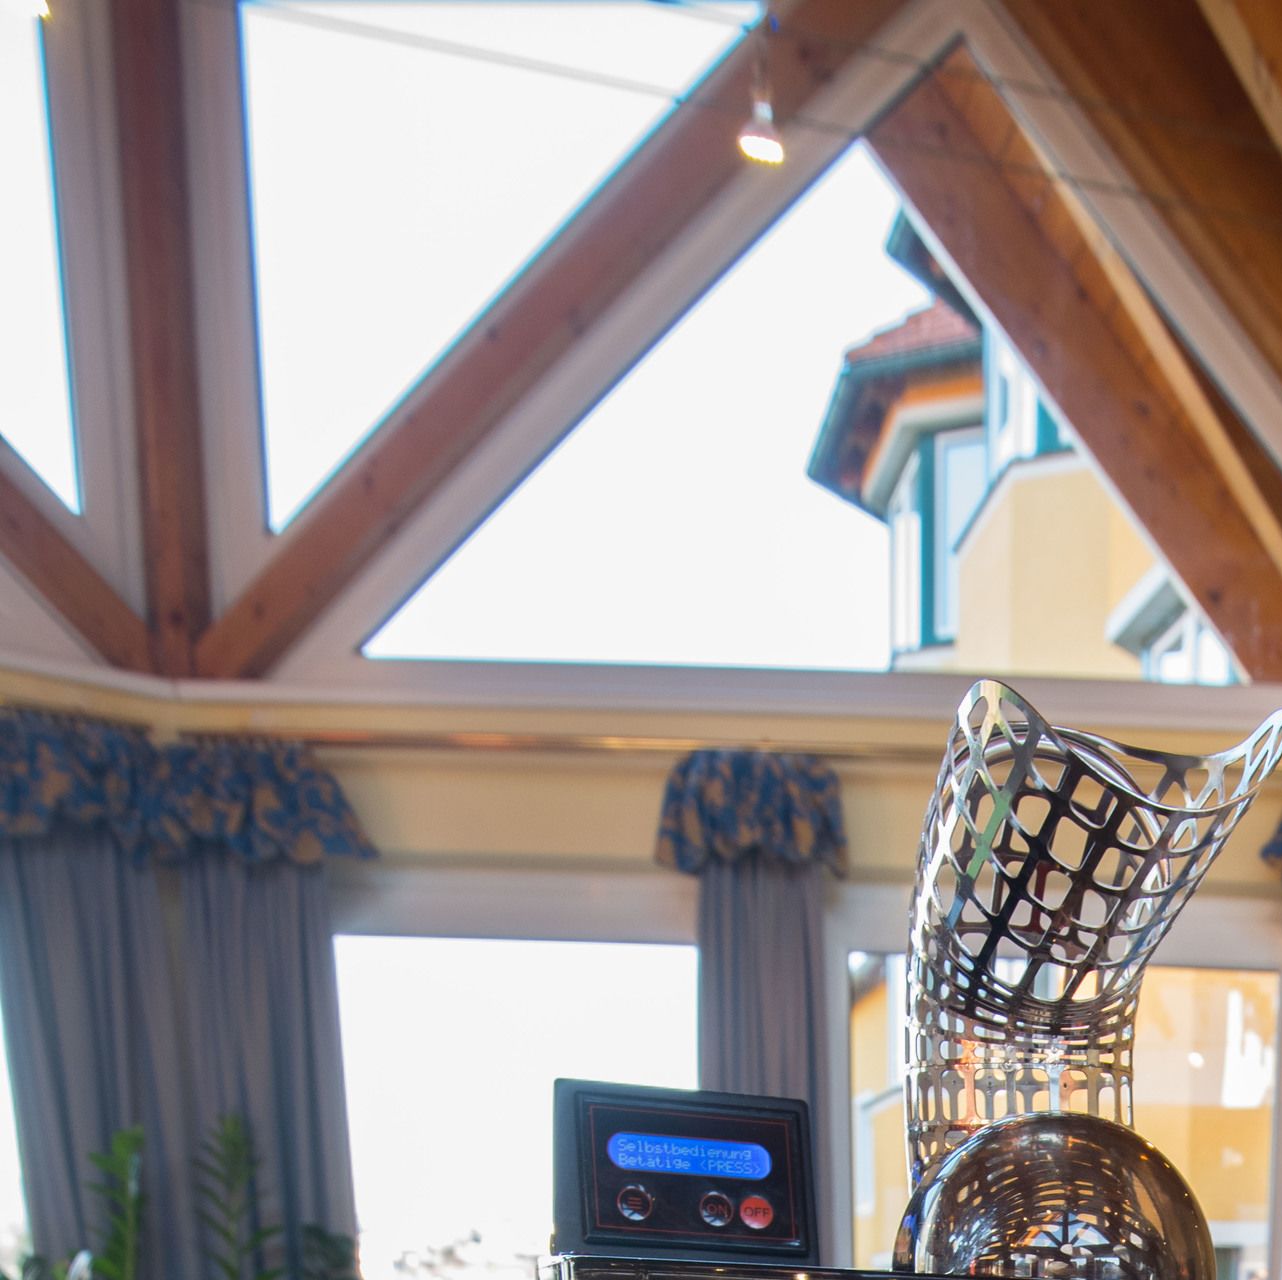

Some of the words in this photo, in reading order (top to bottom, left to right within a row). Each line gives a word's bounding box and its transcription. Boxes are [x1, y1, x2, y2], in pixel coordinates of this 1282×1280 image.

[617, 1139, 752, 1160] Selbstbedienung
[706, 1203, 728, 1218] ON
[744, 1206, 770, 1217] OFF
